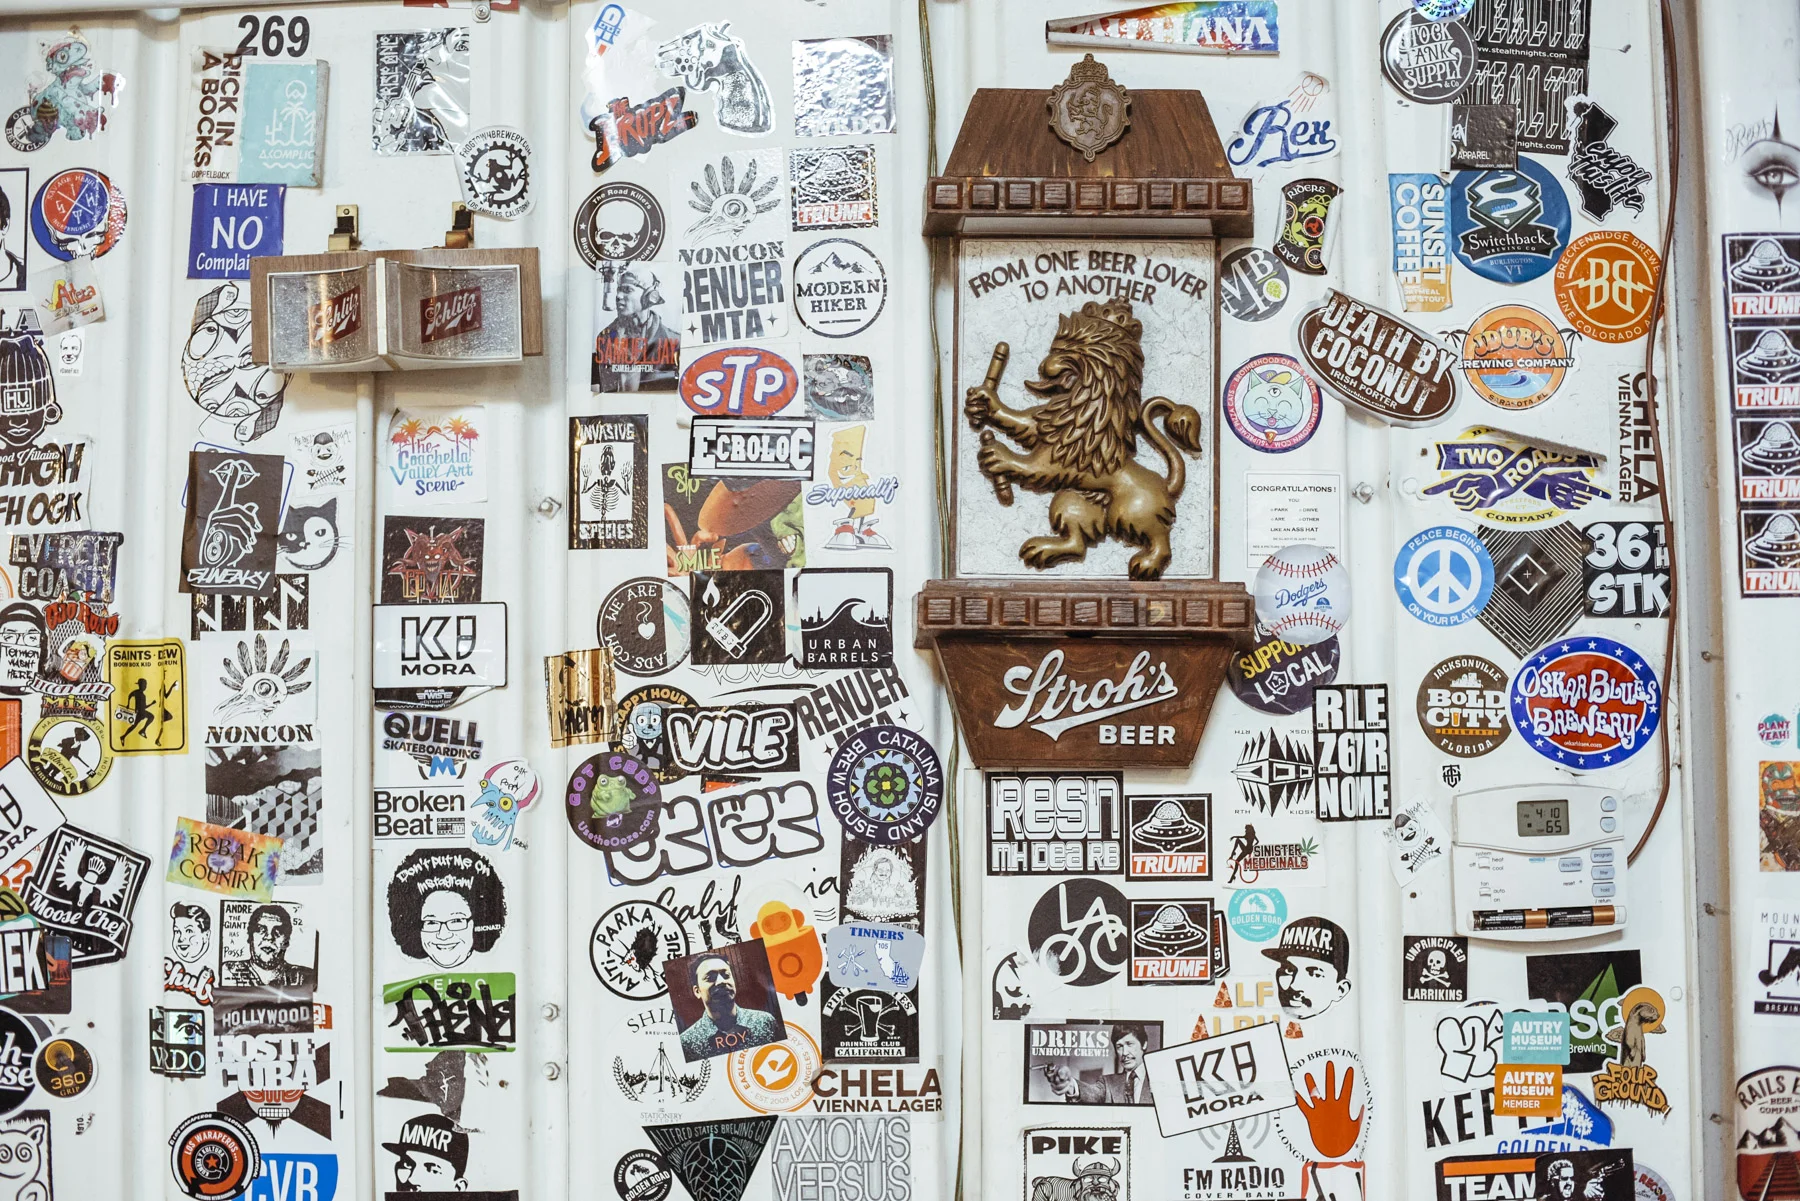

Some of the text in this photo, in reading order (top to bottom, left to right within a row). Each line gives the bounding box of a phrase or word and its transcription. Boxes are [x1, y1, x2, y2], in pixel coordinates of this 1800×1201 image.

[239, 15, 310, 57] 269
[1403, 62, 1462, 89] SUPPLY
[192, 51, 221, 169] A BOCKS
[214, 121, 234, 147] IN
[1227, 100, 1336, 168] Rex
[1457, 150, 1490, 160] APPAREL
[213, 188, 268, 208] I HAVE
[607, 187, 651, 211] Road Killers
[1286, 183, 1326, 200] RIDERS
[211, 215, 265, 250] NO
[1395, 182, 1420, 284] COFFEE
[1420, 182, 1446, 284] SUNSET
[1467, 231, 1552, 251] Switchback
[680, 241, 784, 266] NONCON
[1485, 246, 1525, 254] BREWING
[1556, 231, 1630, 280] BRECKENRIDGE
[967, 249, 1208, 300] FROM ONE BEER LOVER
[796, 279, 879, 298] MODERN
[1020, 274, 1157, 304] TO ANOTHER
[424, 291, 478, 337] Schlitz
[810, 300, 868, 313] HIKER
[1557, 292, 1643, 342] FINE COLORADO
[701, 306, 766, 342] MTA
[1321, 296, 1458, 385] DEATH BY
[1473, 326, 1554, 357] JDUB'S
[595, 337, 651, 367] SAMUEL
[1515, 357, 1575, 369] COMPANY
[1310, 327, 1438, 414] COCONUT
[692, 355, 784, 411] STP
[1330, 368, 1398, 411] IRISH PORTER
[1536, 391, 1549, 401] FL
[580, 422, 635, 441] INVASIVE
[1617, 372, 1633, 504] VIENNA LAGER
[1632, 371, 1662, 504] CHELA
[17, 449, 61, 467] Villains
[398, 448, 472, 471] Coachella
[1454, 447, 1505, 467] TWO
[445, 463, 474, 478] Art
[414, 478, 464, 496] Scene
[1485, 510, 1555, 522] COMPANY
[580, 521, 634, 541] SPECIES
[1408, 530, 1482, 553] PEACE BEGINS
[676, 548, 722, 573] SMILE
[604, 584, 658, 623] WE ARE
[1275, 578, 1328, 609] Dodgers
[1586, 573, 1671, 615] STK
[1408, 603, 1480, 625] ON YOUR PLATE
[113, 649, 152, 661] SAINTS
[808, 639, 877, 650] URBAN
[807, 651, 879, 663] BARRELS
[401, 663, 477, 676] MORA
[1433, 659, 1502, 681] JACKSONVILLE
[650, 687, 689, 706] HOUR
[793, 662, 909, 741] RENUER
[993, 649, 1178, 742] Stroh's
[1427, 687, 1507, 708] BOLD
[205, 724, 313, 743] NONCON
[383, 711, 483, 749] QUELL
[1099, 724, 1175, 745] BEER
[1757, 722, 1791, 734] PLANT
[383, 740, 481, 761] SKATEBOARDING
[670, 709, 793, 770] VILE
[1440, 737, 1494, 755] FLORIDA
[568, 763, 595, 807] GOT
[834, 730, 939, 841] CATALINA ISLAND BREW HOUSE
[374, 790, 465, 814] Broken
[1536, 808, 1560, 819] 4:10
[374, 814, 433, 837] Beat
[1545, 821, 1562, 834] 65
[189, 832, 263, 869] ROBAK
[1253, 843, 1303, 857] SINISTER
[1132, 855, 1204, 873] TRIUMF
[1243, 856, 1309, 870] MEDICINALS
[180, 859, 264, 891] COUNTRY
[29, 895, 127, 942] Moose Chef
[225, 904, 253, 915] ANDRE
[1230, 912, 1283, 926] GOLDEN ROAD
[224, 921, 248, 930] GIANT
[595, 905, 654, 947] PARKA
[849, 925, 905, 941] TINNERS
[1404, 937, 1466, 963] UNPRINCIPLED
[1134, 959, 1206, 978] TRIUMF
[1407, 988, 1464, 1001] LARRIKINS
[223, 1006, 309, 1028] HOLLYWOOD
[1510, 1020, 1563, 1035] AUTRY
[714, 1031, 748, 1049] ROY
[1031, 1029, 1109, 1048] DREKS
[1510, 1034, 1563, 1046] MUSEUM
[837, 1048, 904, 1057] CALIFORNIA
[1031, 1047, 1071, 1057] UNHOLY
[50, 1072, 86, 1090] 360
[810, 1069, 942, 1098] CHELA
[1502, 1071, 1555, 1085] AUTRY
[1612, 1063, 1657, 1086] FOUR
[60, 1085, 80, 1097] GRIP
[1502, 1085, 1555, 1096] MUSEUM
[1594, 1079, 1668, 1106] GROUND
[1737, 1075, 1786, 1110] RAILS
[1770, 1097, 1792, 1105] BEER
[813, 1099, 943, 1113] VIENNA LAGER
[1187, 1093, 1264, 1119] MORA
[1502, 1099, 1541, 1109] MEMBER
[184, 1140, 197, 1156] LOS
[402, 1122, 452, 1153] MNKR
[649, 1125, 719, 1155] ALTERED STATES
[772, 1117, 911, 1163] AXIOMS
[1031, 1136, 1122, 1154] PIKE
[650, 1169, 671, 1187] ROAD
[771, 1161, 911, 1201] VERSUS
[1184, 1166, 1285, 1191] FM RADIO
[1184, 1190, 1285, 1199] COVER BAND
